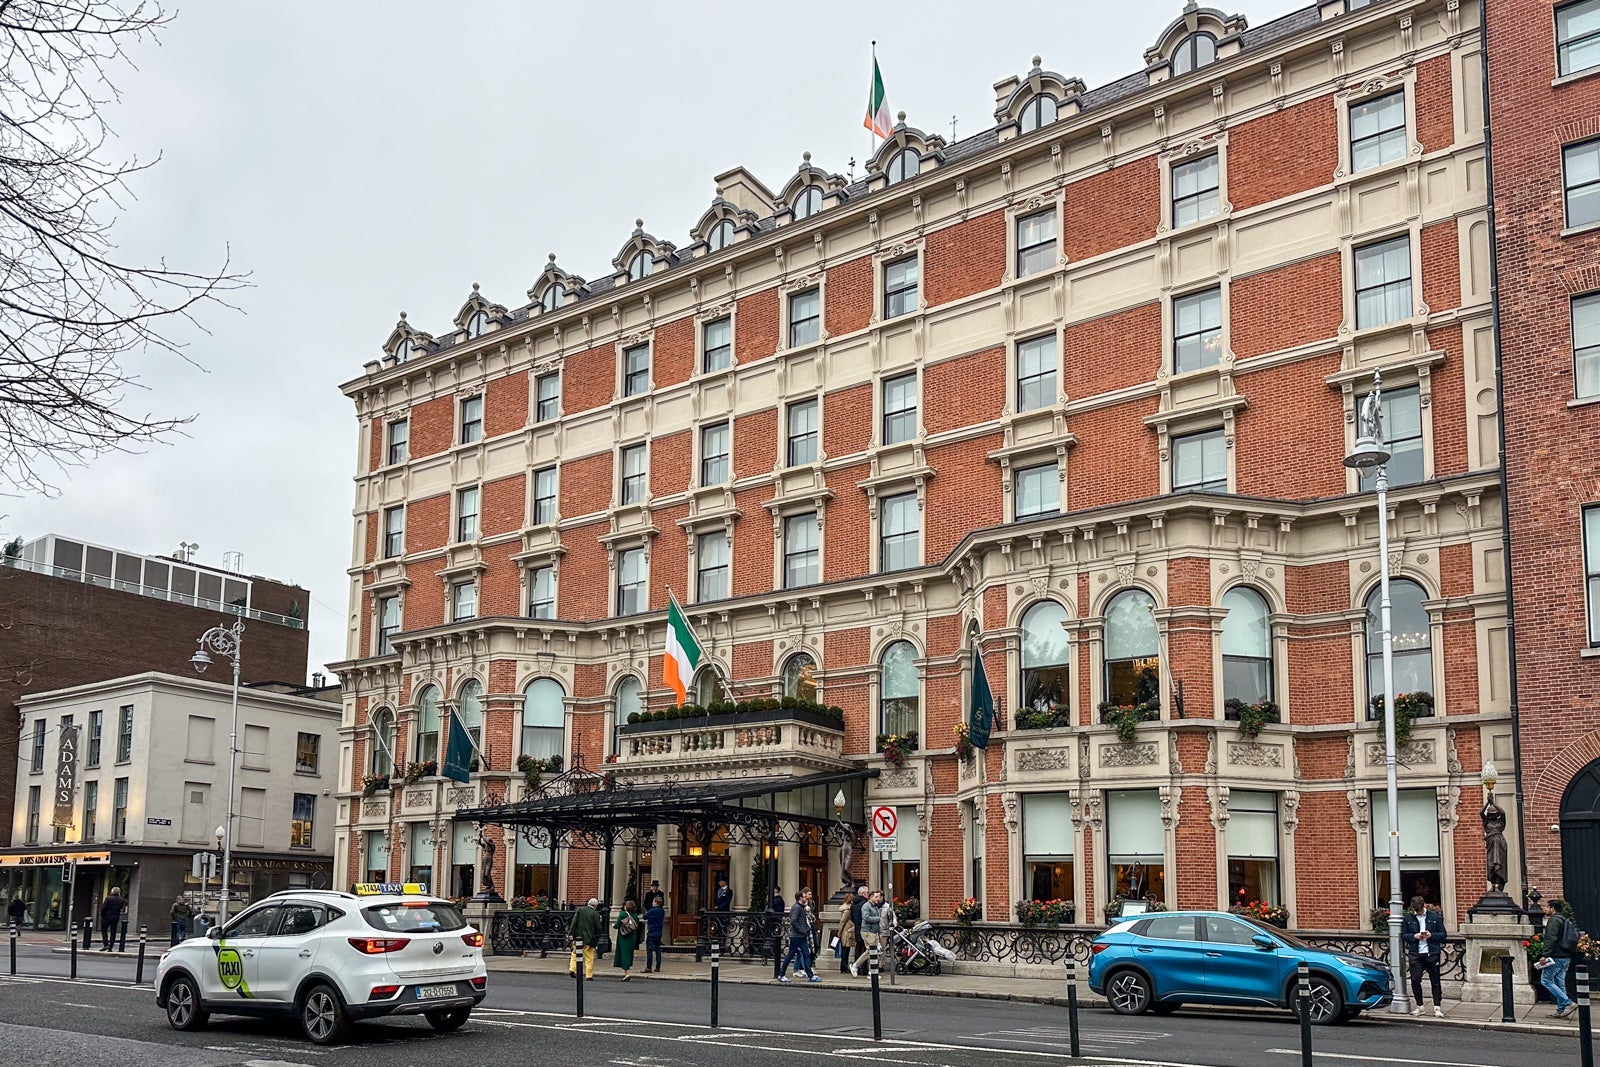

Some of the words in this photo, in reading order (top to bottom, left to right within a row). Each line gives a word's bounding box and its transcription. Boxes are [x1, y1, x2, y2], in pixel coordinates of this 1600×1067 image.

[59, 738, 75, 802] ADAMS
[622, 771, 723, 784] SHELBOURNE
[730, 767, 784, 778] HOTEL
[19, 856, 34, 865] JAMES
[35, 856, 49, 864] ADAM
[54, 855, 68, 864] SONS
[231, 859, 262, 868] JAMES
[262, 860, 290, 869] ADAM
[301, 862, 324, 871] SONS
[381, 884, 402, 893] TAXI
[220, 962, 240, 976] TAXI
